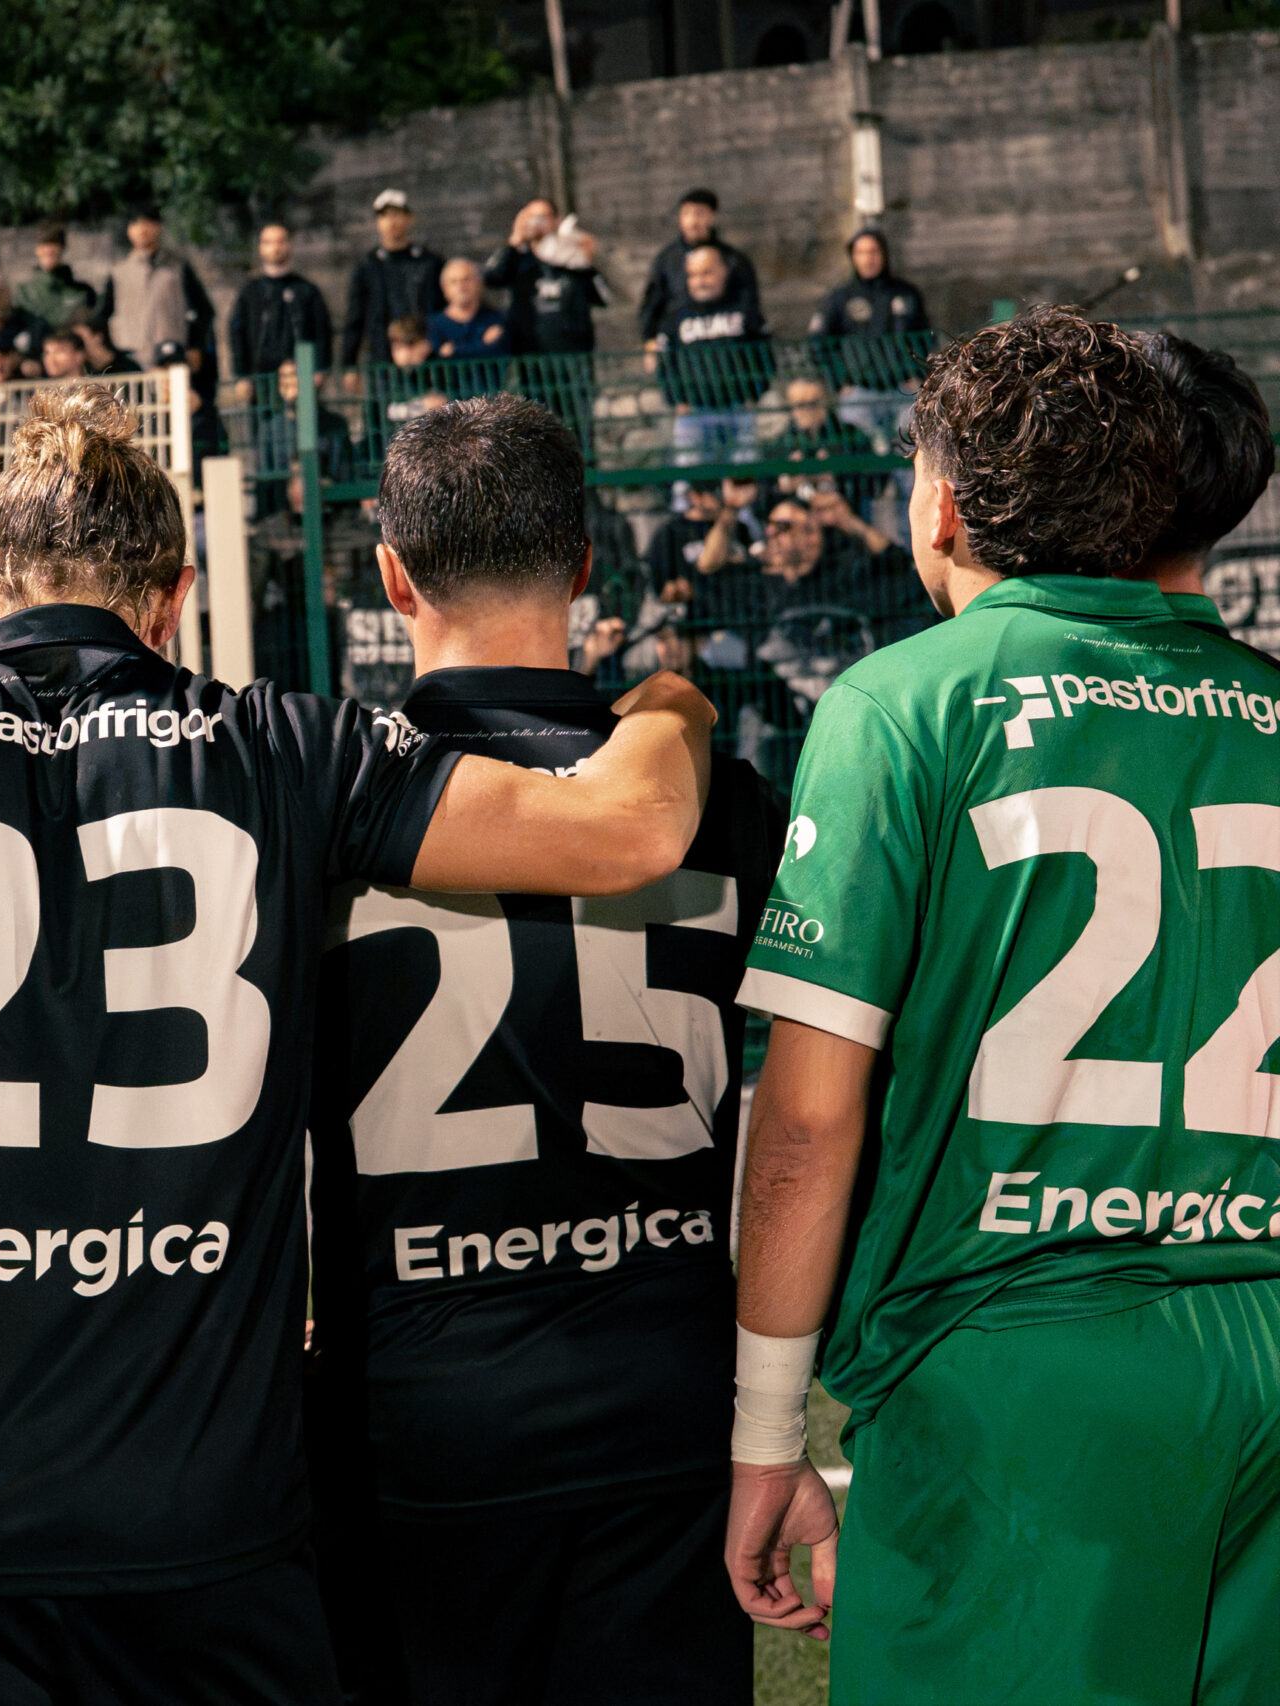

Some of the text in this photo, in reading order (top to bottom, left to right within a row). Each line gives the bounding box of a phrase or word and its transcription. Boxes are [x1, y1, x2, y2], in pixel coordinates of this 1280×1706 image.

[1051, 673, 1280, 735] pastorfrig
[754, 935, 815, 960] SERRAMENTI
[758, 908, 825, 945] FIRO
[324, 868, 738, 1175] 25
[394, 1201, 715, 1282] Energica
